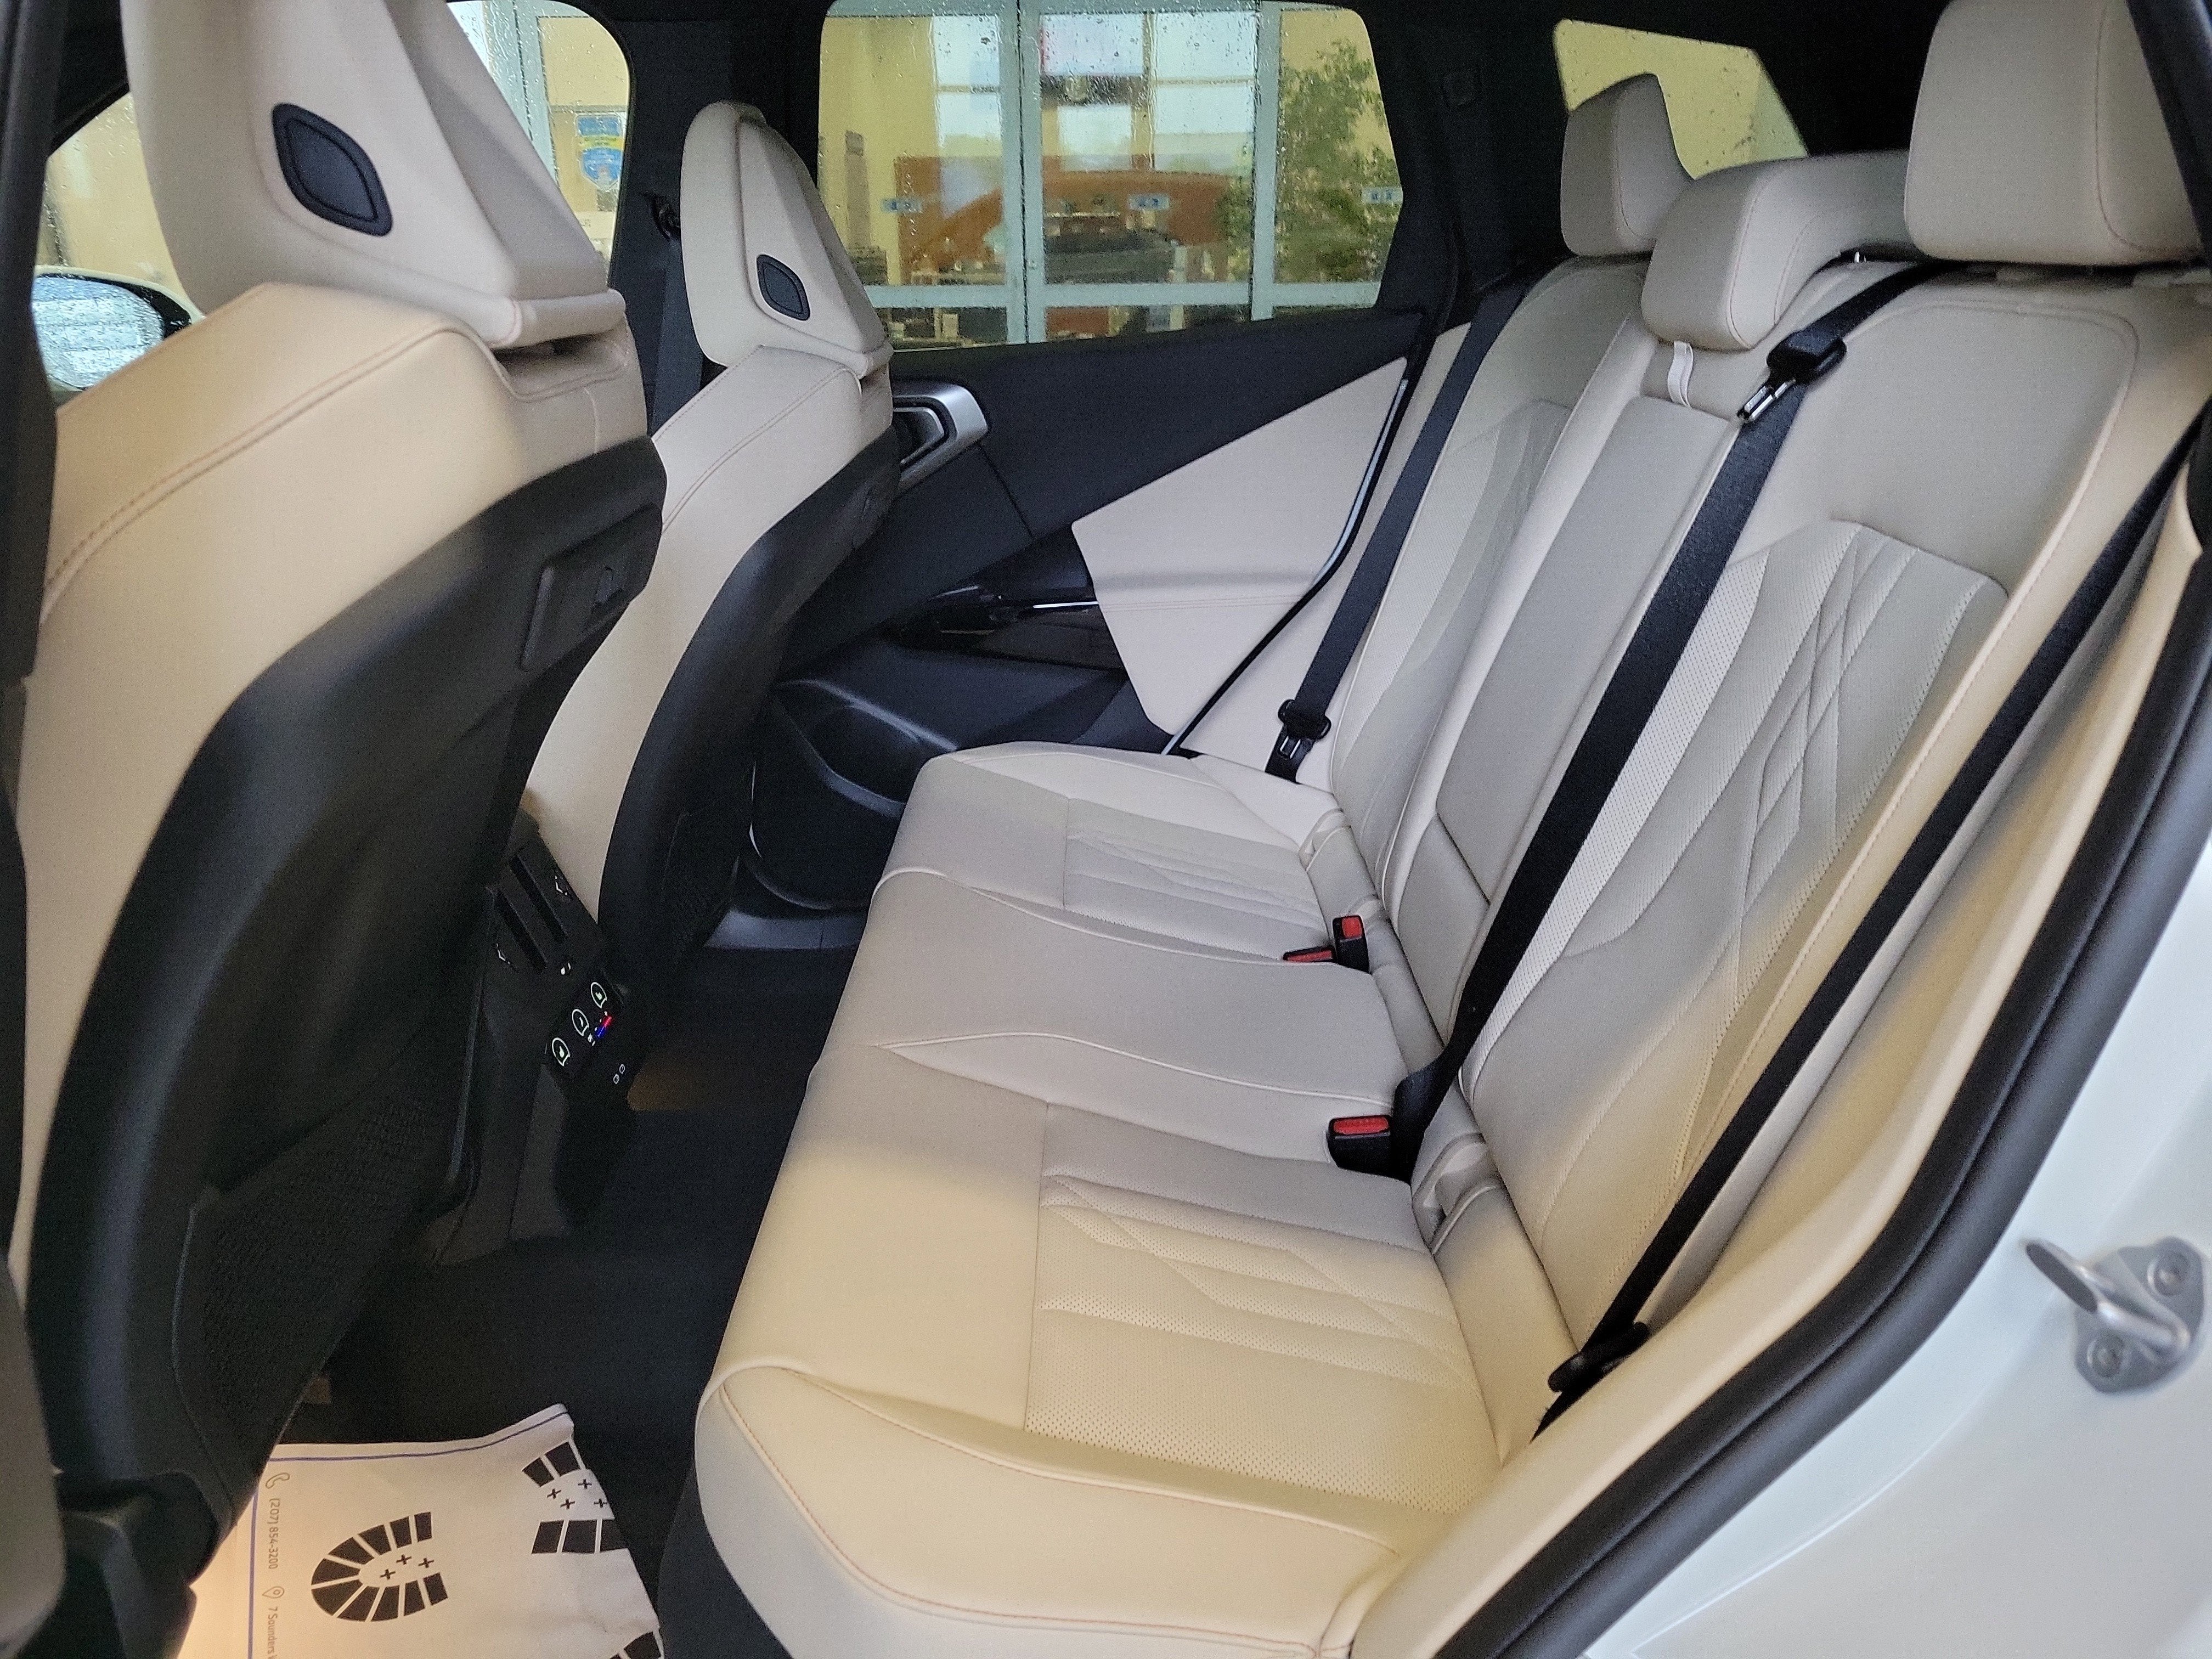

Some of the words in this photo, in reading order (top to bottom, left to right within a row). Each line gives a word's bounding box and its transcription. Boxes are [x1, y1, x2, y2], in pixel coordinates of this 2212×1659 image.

[267, 1498, 280, 1524] (207)
[268, 1526, 278, 1570] 854-3200
[267, 1613, 278, 1654] Saunders
